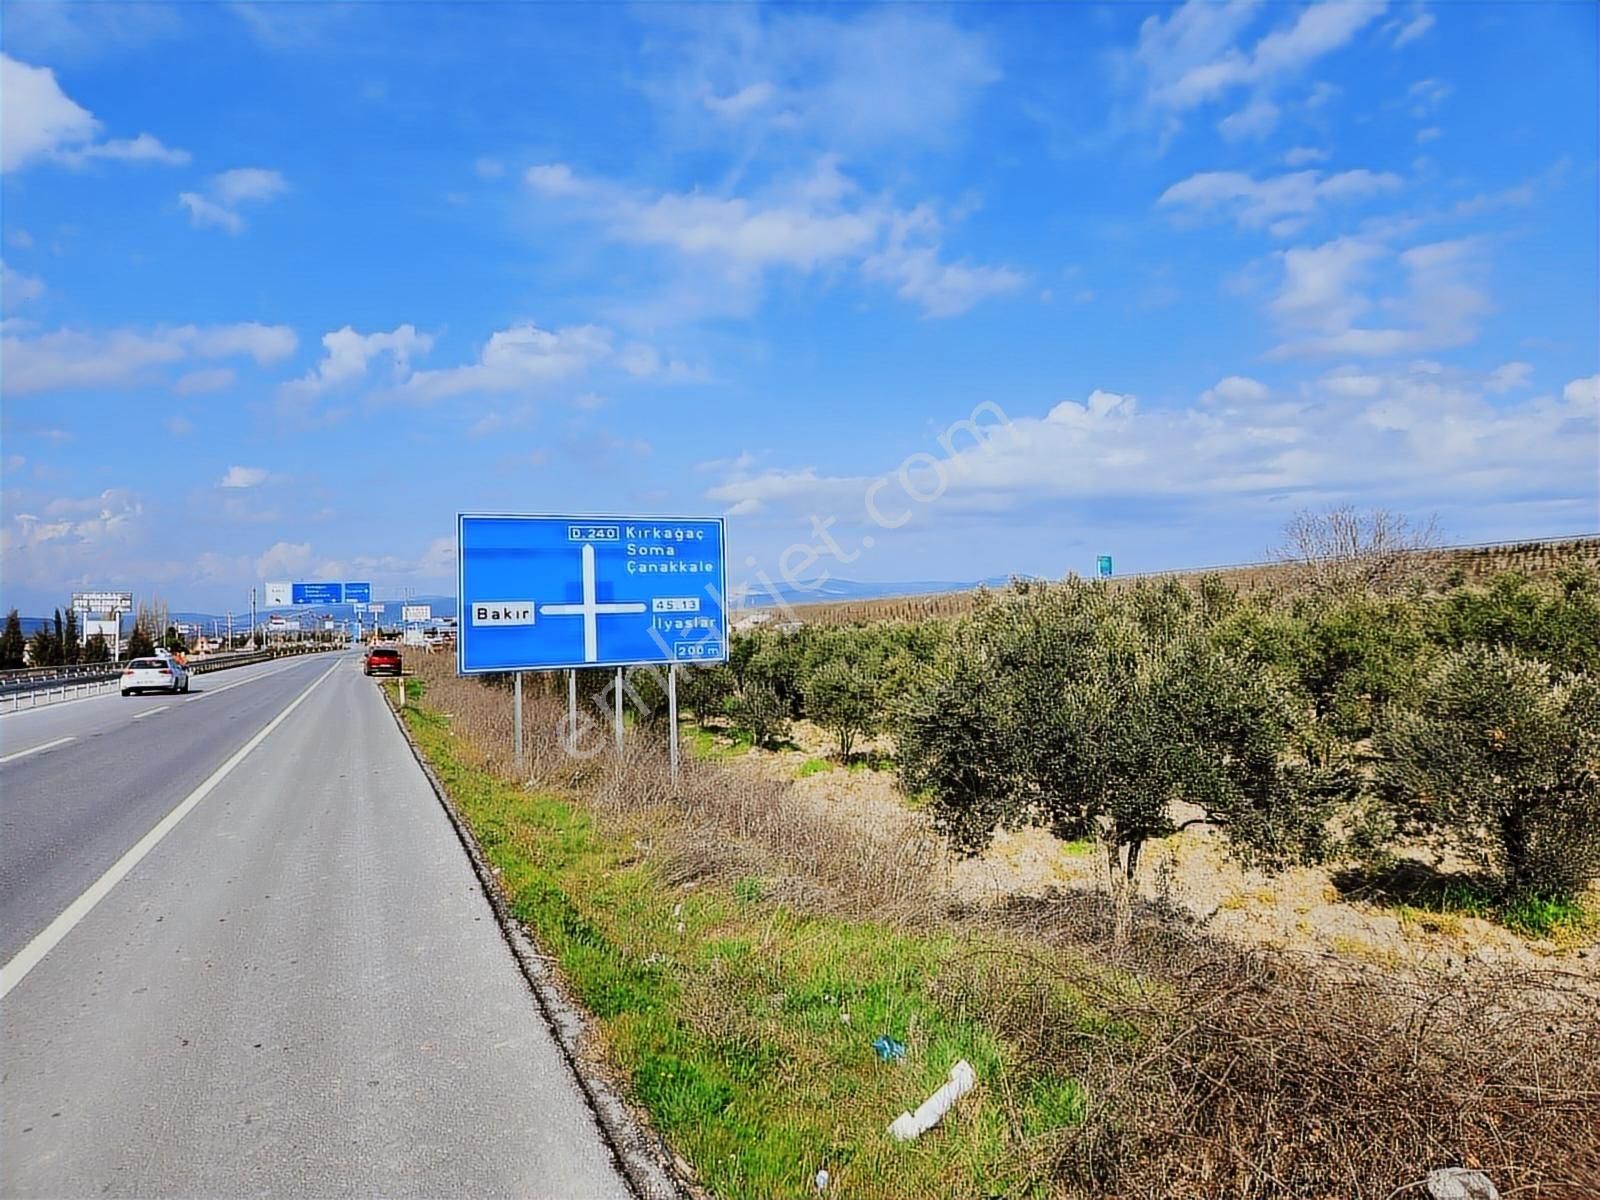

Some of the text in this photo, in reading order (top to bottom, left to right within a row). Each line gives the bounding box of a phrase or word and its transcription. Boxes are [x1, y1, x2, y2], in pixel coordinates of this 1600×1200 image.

[572, 528, 615, 538] D.240
[626, 526, 704, 541] Kırkağaç
[627, 544, 675, 556] Soma
[627, 560, 713, 575] Çanakkale
[477, 607, 529, 620] Bakır
[678, 646, 719, 656] 200 m
